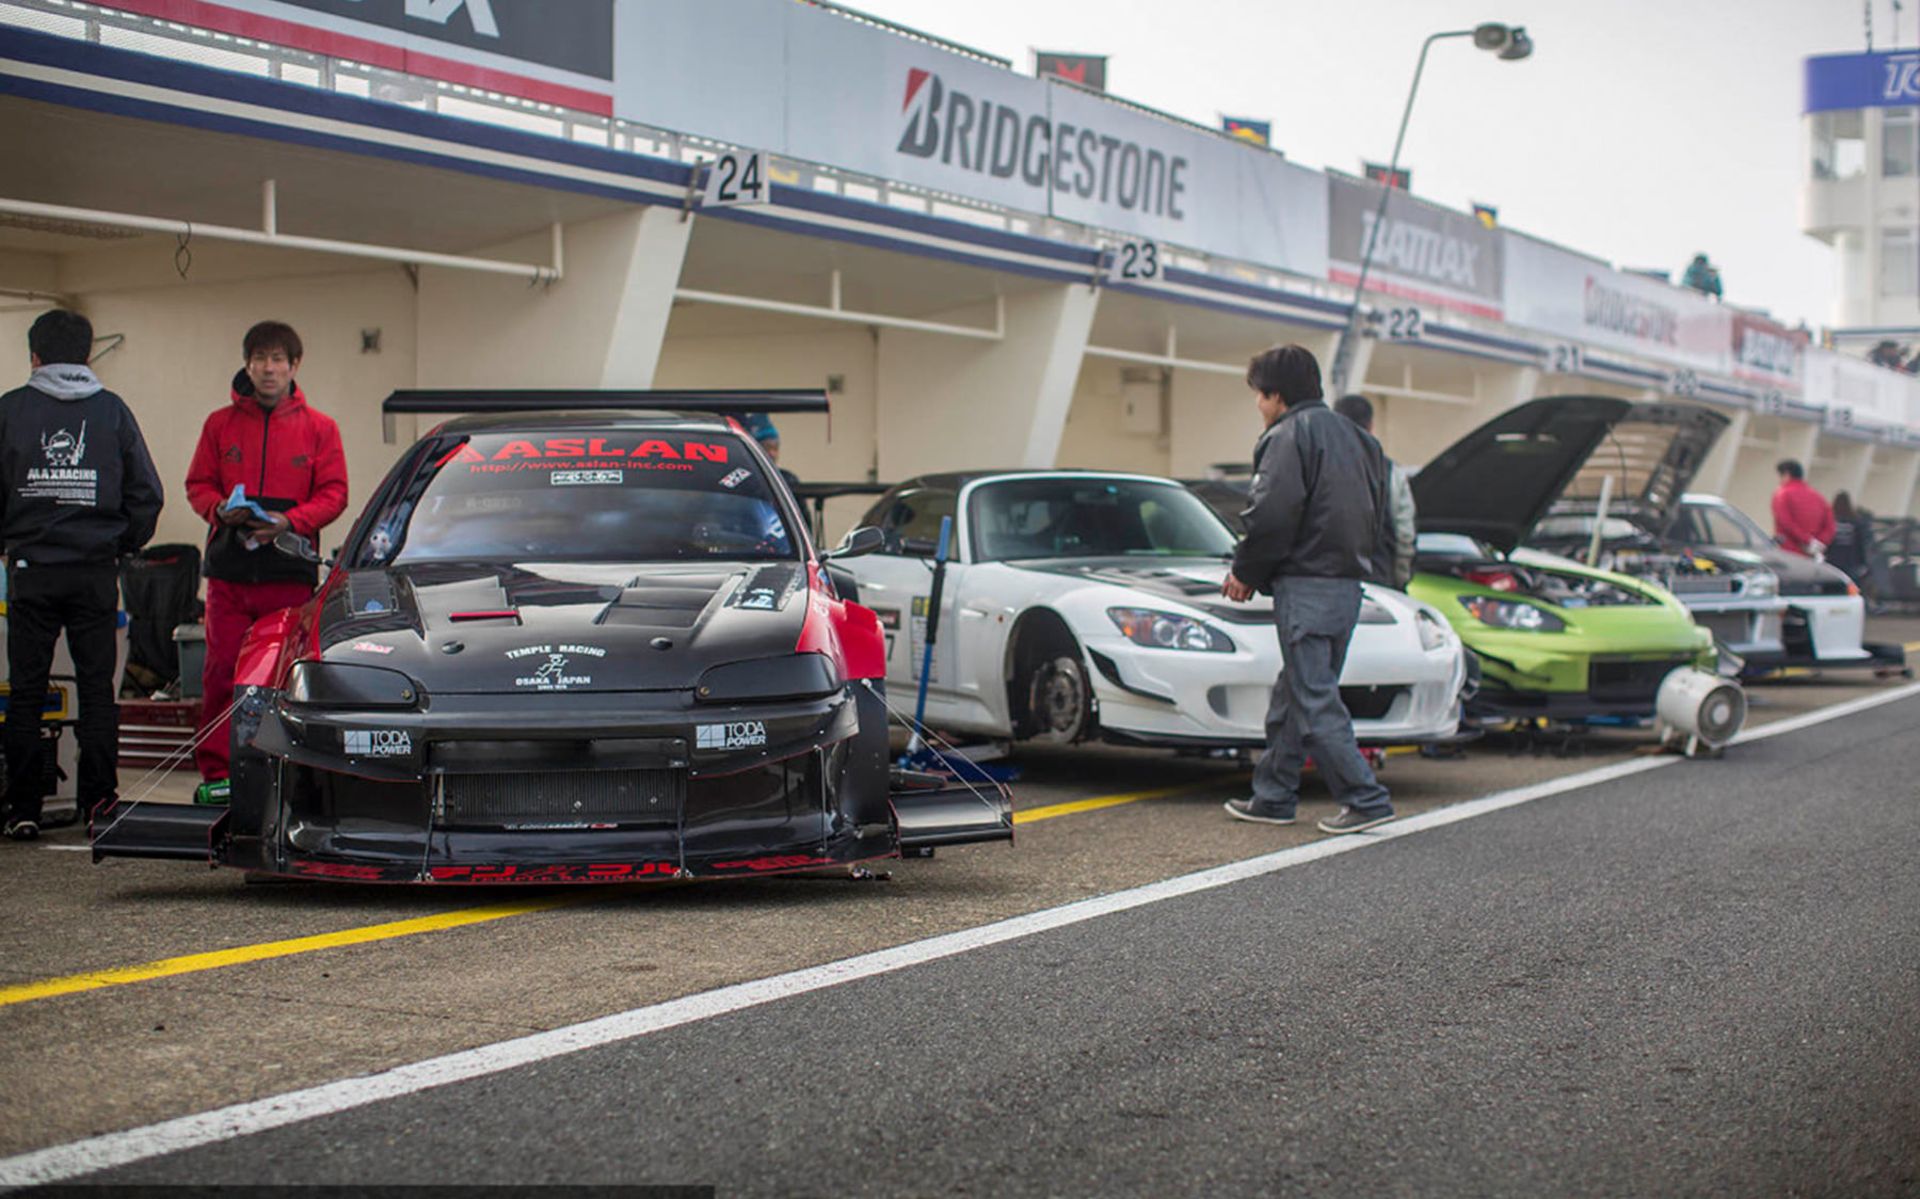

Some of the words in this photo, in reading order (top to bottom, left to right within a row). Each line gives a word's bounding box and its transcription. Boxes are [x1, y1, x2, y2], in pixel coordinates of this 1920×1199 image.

[897, 67, 1188, 220] BRIDGESTONE
[718, 154, 762, 201] 24
[1122, 242, 1157, 278] 23
[1389, 307, 1421, 337] 22
[491, 438, 729, 464] ASLAN
[504, 645, 552, 660] TEMPLE
[558, 644, 607, 658] RACING
[515, 677, 550, 687] OSAKA
[725, 721, 766, 737] TODA
[371, 730, 411, 745] TODA
[726, 735, 766, 748] POWER
[371, 744, 411, 755] POWER
